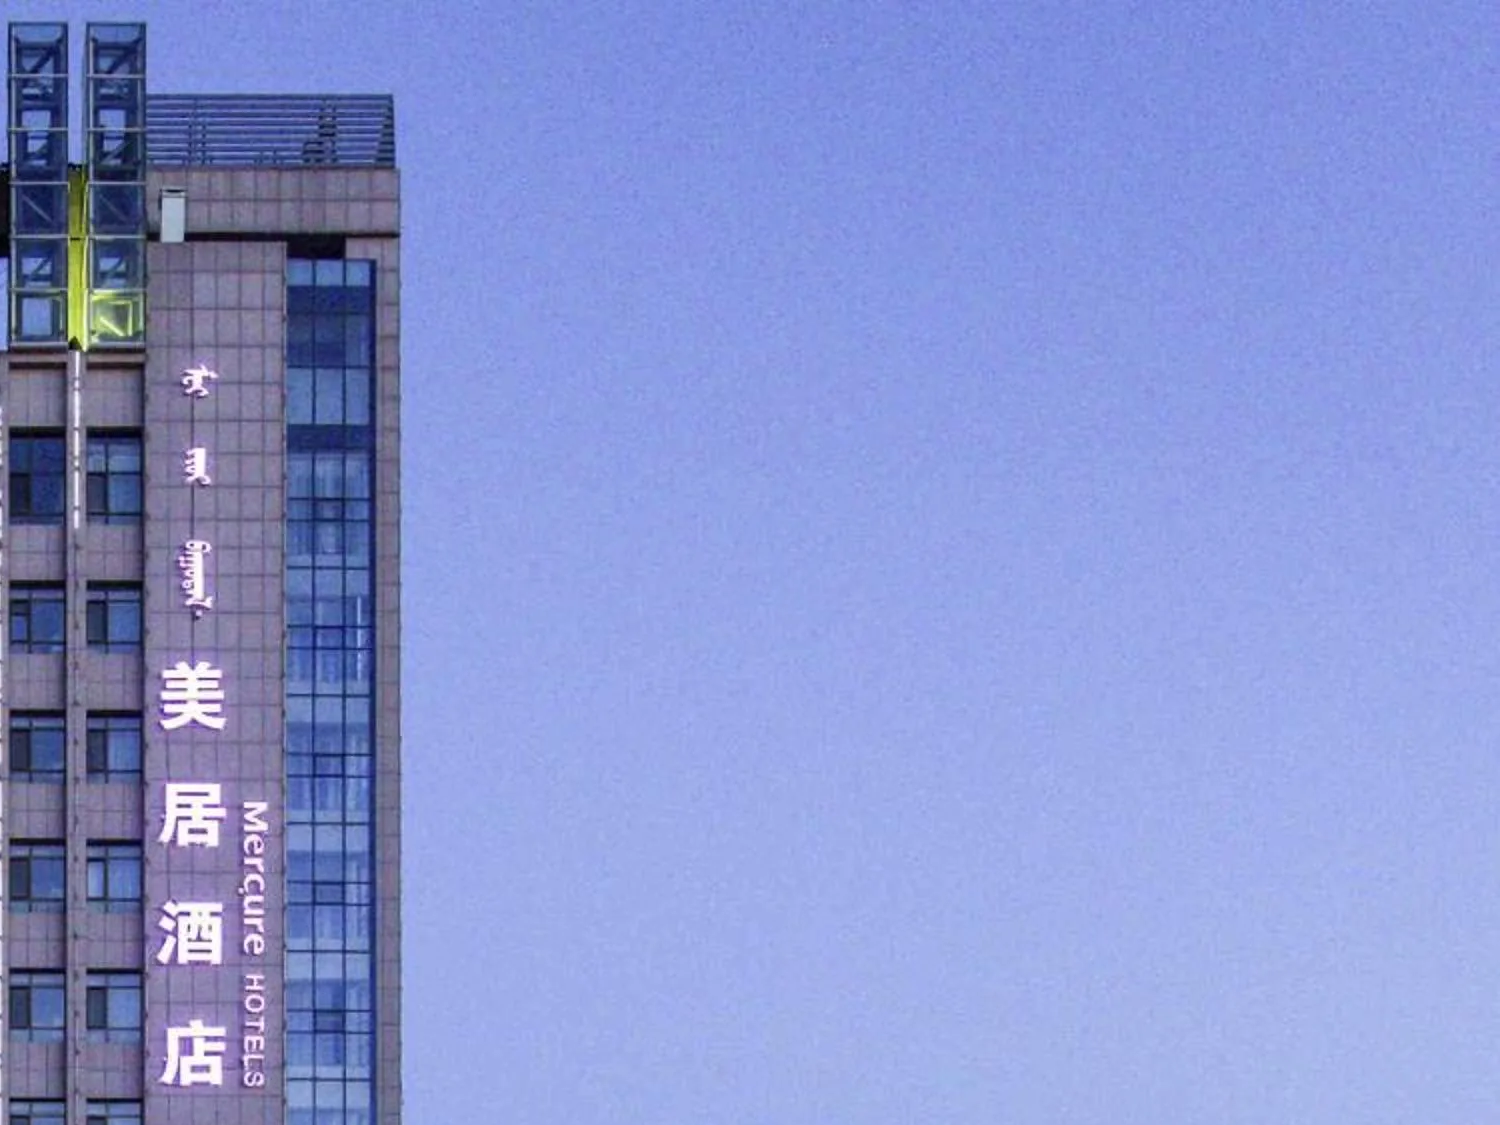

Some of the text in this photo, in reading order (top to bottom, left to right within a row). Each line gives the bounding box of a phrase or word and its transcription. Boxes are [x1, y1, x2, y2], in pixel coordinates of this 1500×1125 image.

[157, 661, 227, 1086] 美居酒店
[239, 801, 269, 1088] Mercure HOTELS
